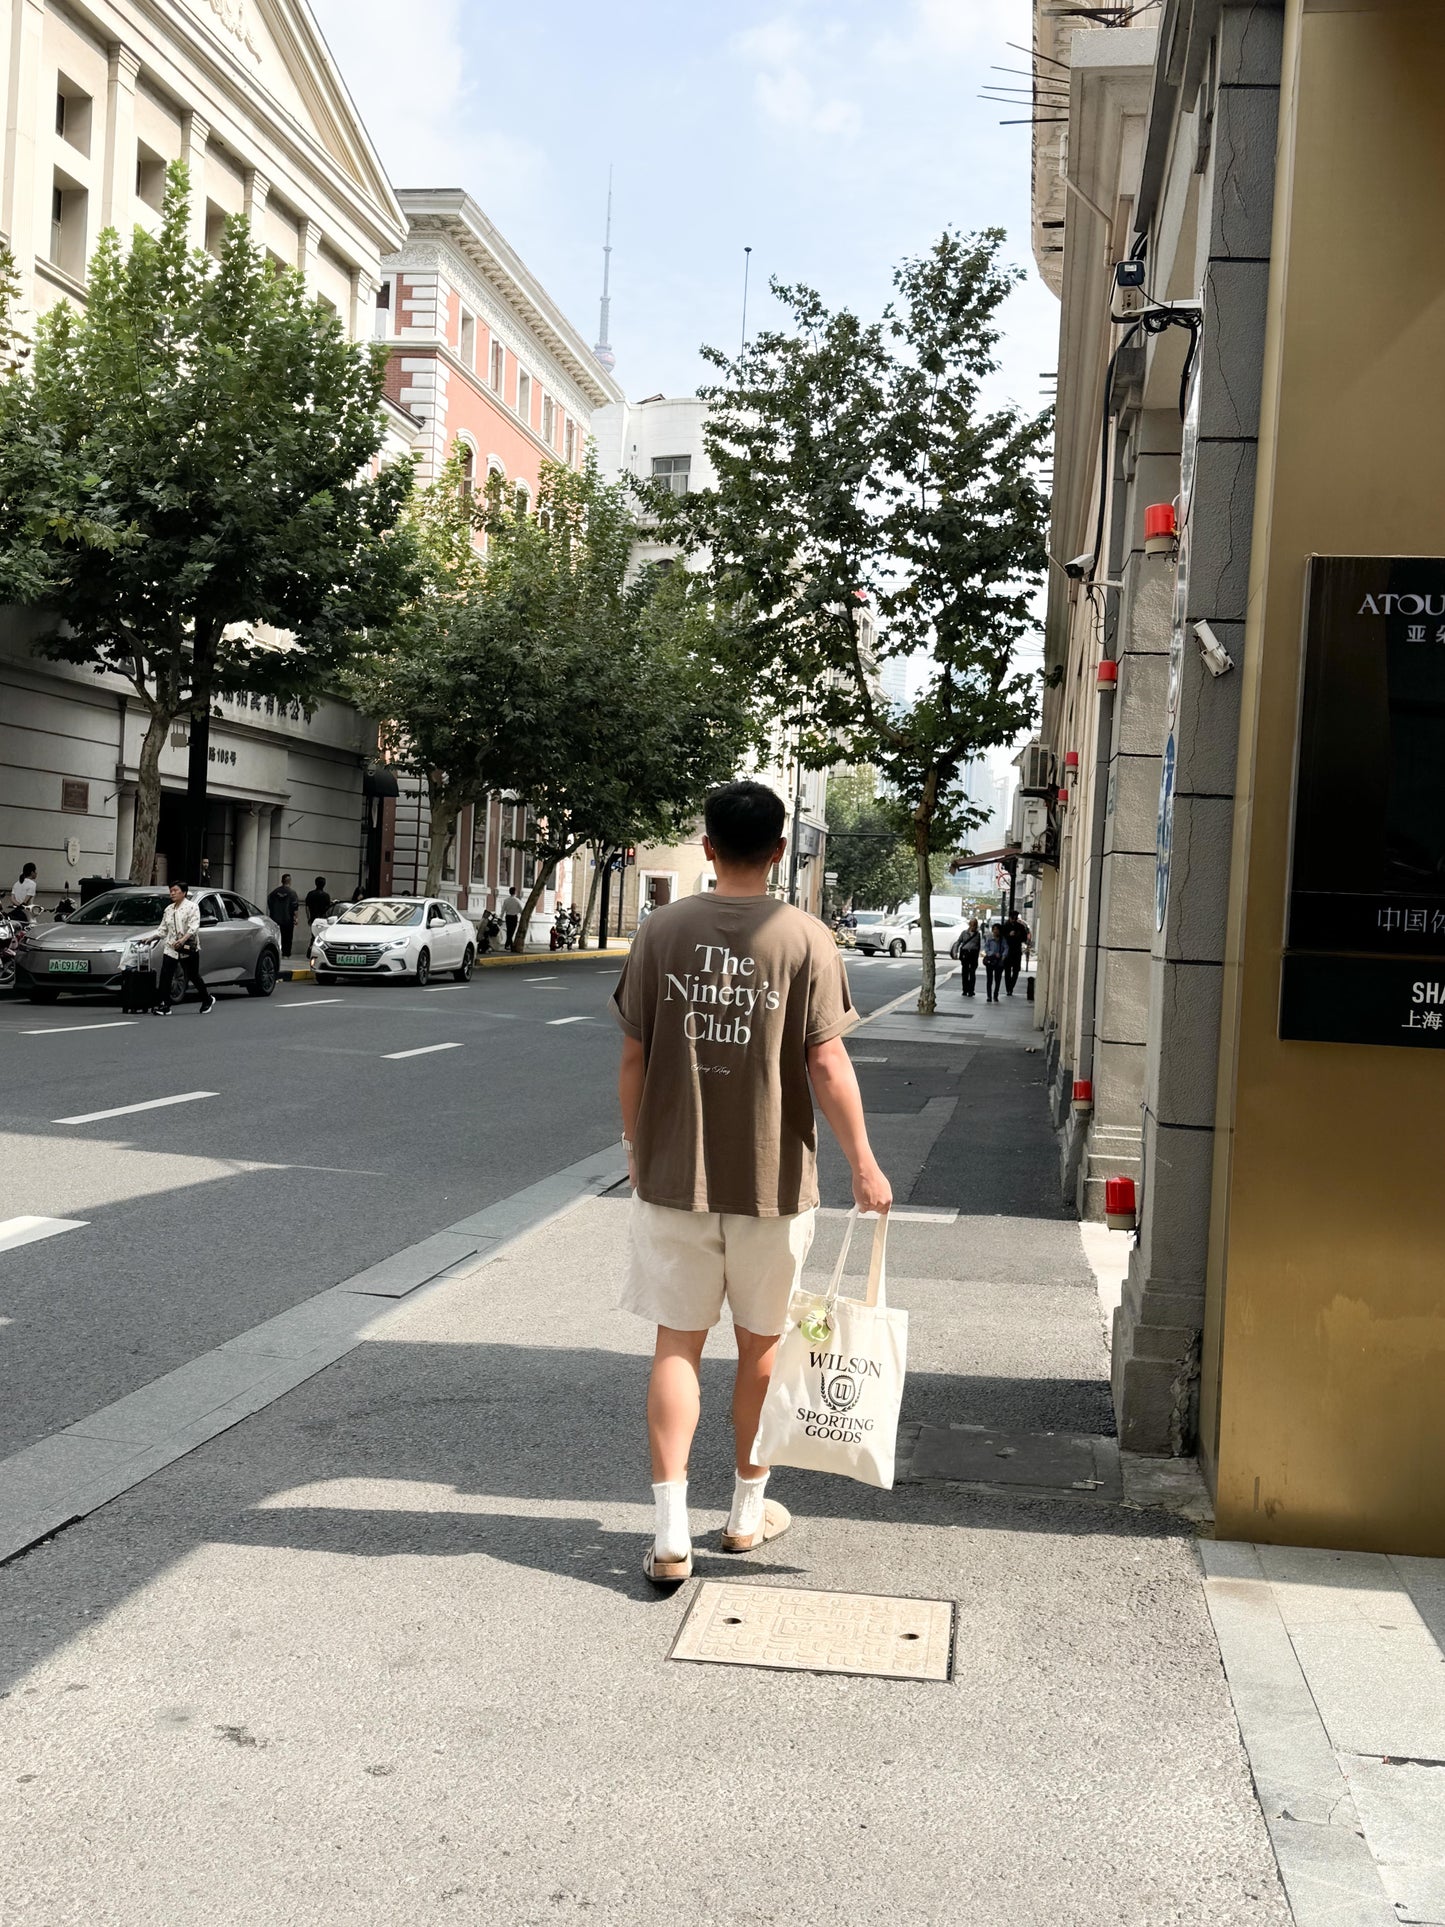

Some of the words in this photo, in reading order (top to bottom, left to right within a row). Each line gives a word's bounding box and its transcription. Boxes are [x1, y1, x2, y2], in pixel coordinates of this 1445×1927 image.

[695, 944, 755, 976] The
[664, 973, 780, 1016] Ninety's
[684, 1011, 752, 1045] Club
[1401, 1009, 1443, 1031] 上海
[809, 1351, 882, 1379] WILSON
[796, 1407, 874, 1431] SPORTING
[805, 1424, 862, 1444] GOODS
